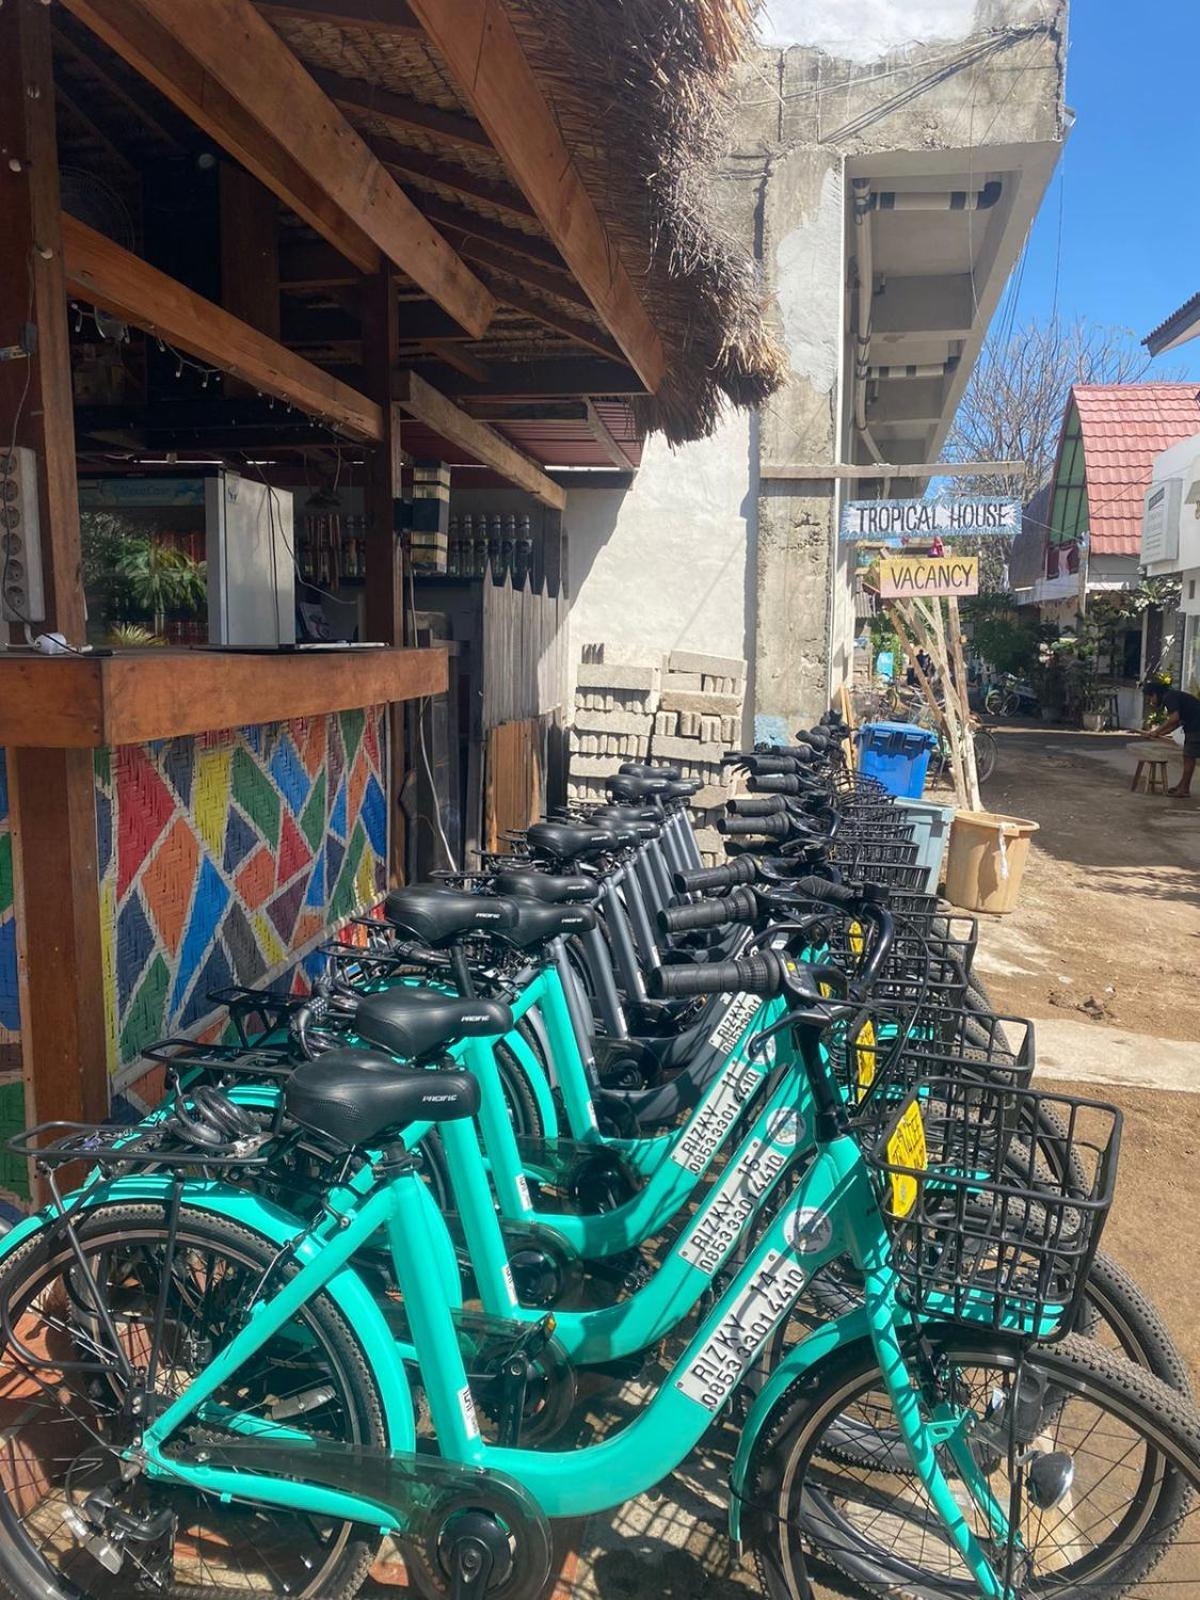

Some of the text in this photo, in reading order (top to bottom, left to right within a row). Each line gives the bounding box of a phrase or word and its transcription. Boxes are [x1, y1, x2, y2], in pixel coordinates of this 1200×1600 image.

[856, 502, 1009, 532] TROPICAL HOUSE
[890, 563, 974, 590] VACANCY
[681, 1105, 719, 1155] RIZKY
[691, 1154, 761, 1249] RIZKY 15
[691, 1270, 779, 1385] RIZKY 14
